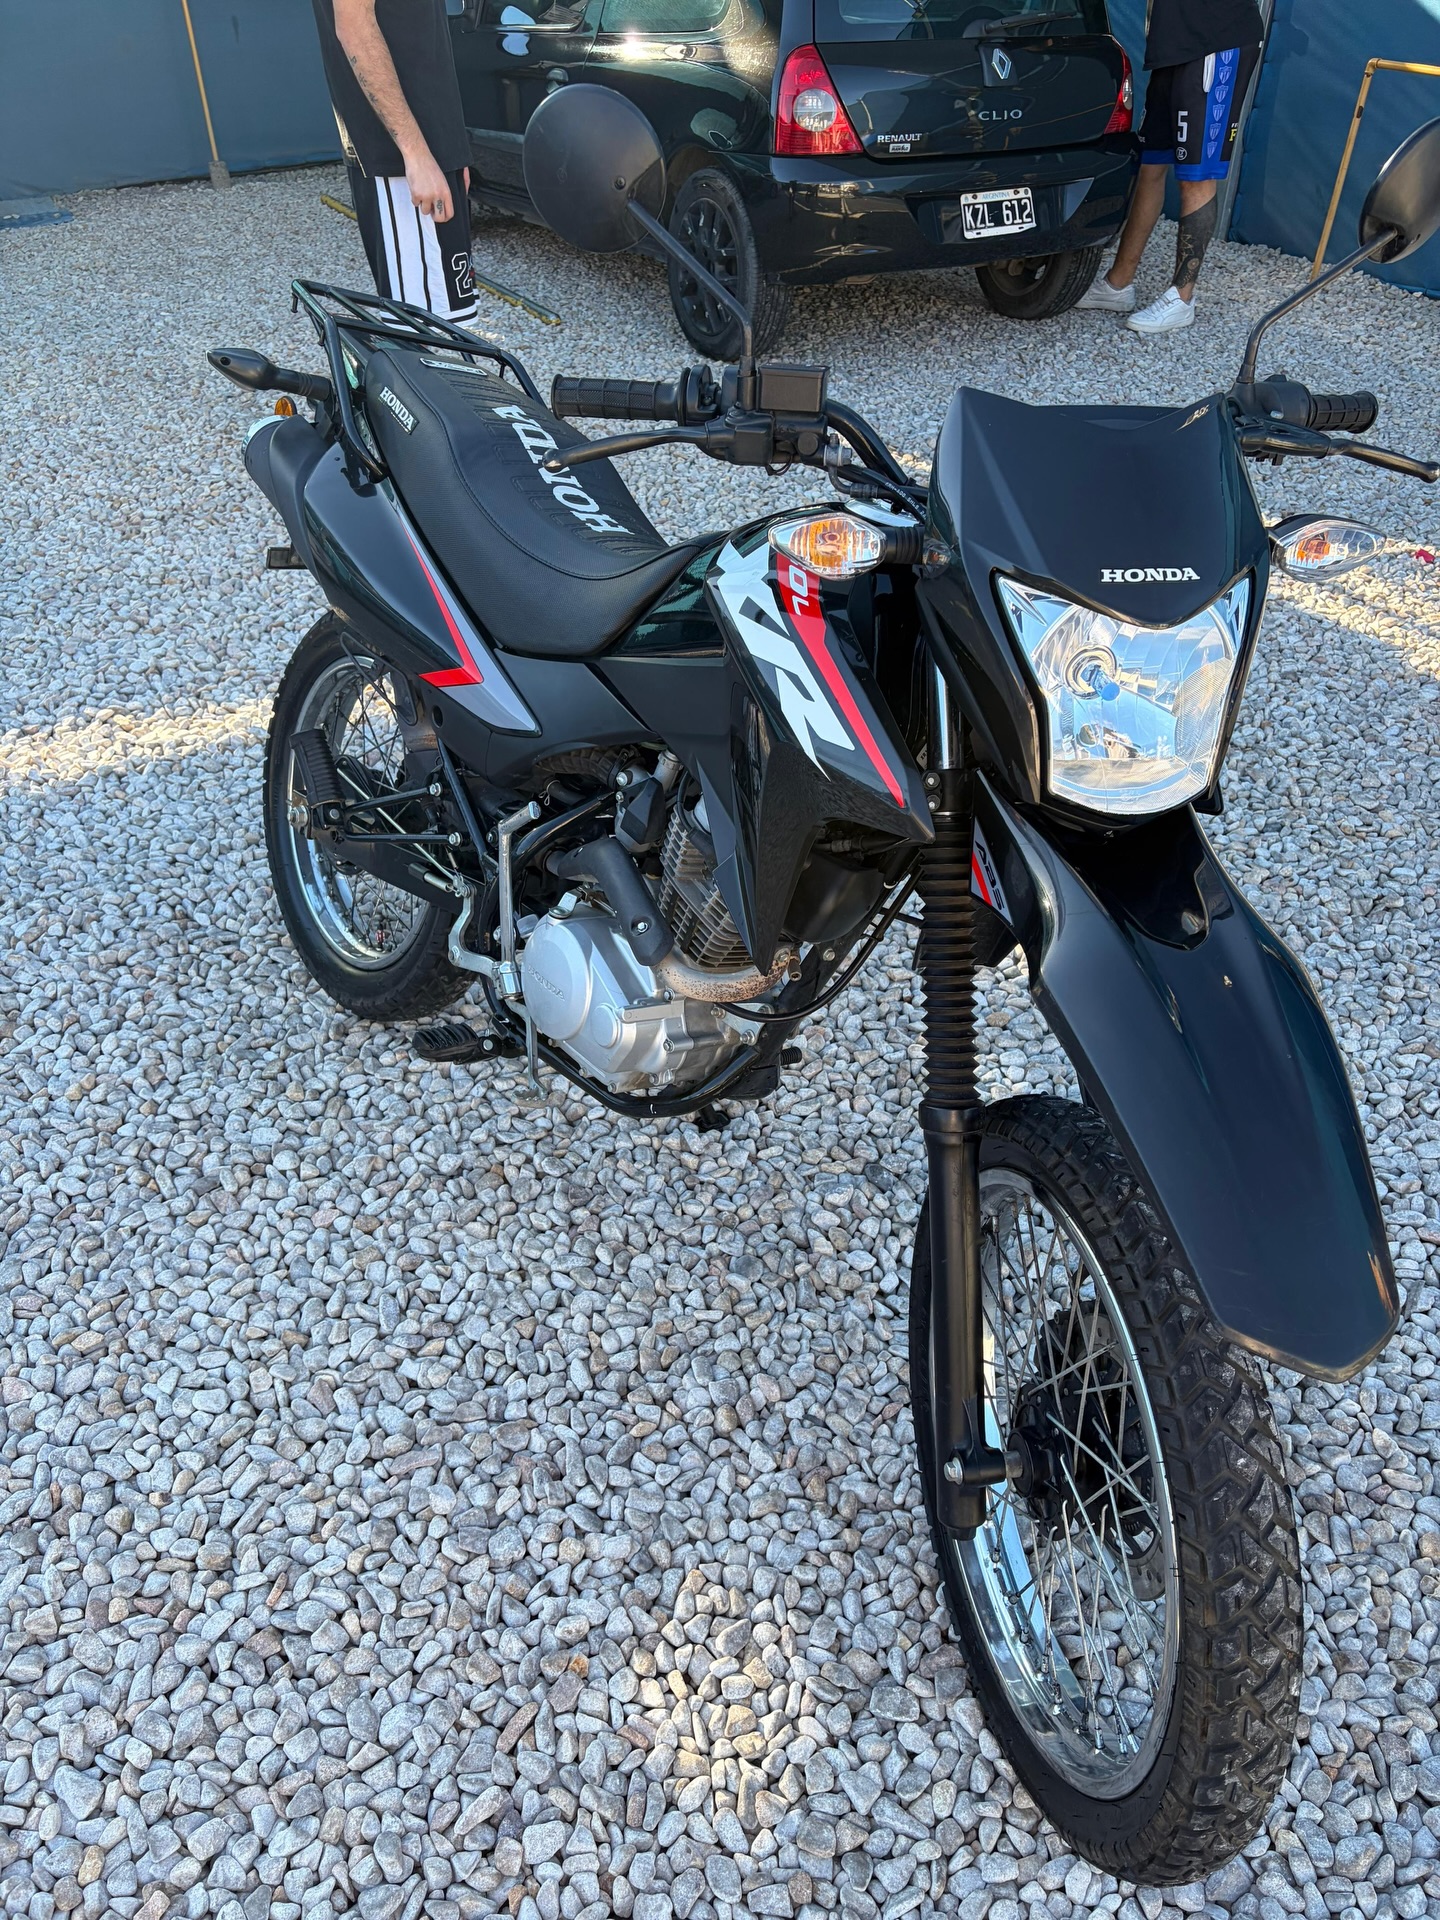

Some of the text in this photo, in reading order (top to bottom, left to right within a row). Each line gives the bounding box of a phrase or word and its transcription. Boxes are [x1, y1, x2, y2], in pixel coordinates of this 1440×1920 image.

[978, 109, 1023, 121] CLIO
[1177, 110, 1189, 143] 5
[877, 133, 923, 143] RENAULT
[964, 198, 1032, 230] KZL 612
[982, 191, 1011, 200] ARGENTINA
[451, 252, 475, 298] 2
[380, 386, 415, 432] HONDA
[492, 404, 636, 536] HONDA
[788, 564, 810, 617] 0L
[1101, 567, 1201, 583] HONDA
[716, 539, 856, 782] XR
[975, 840, 1005, 911] ABS
